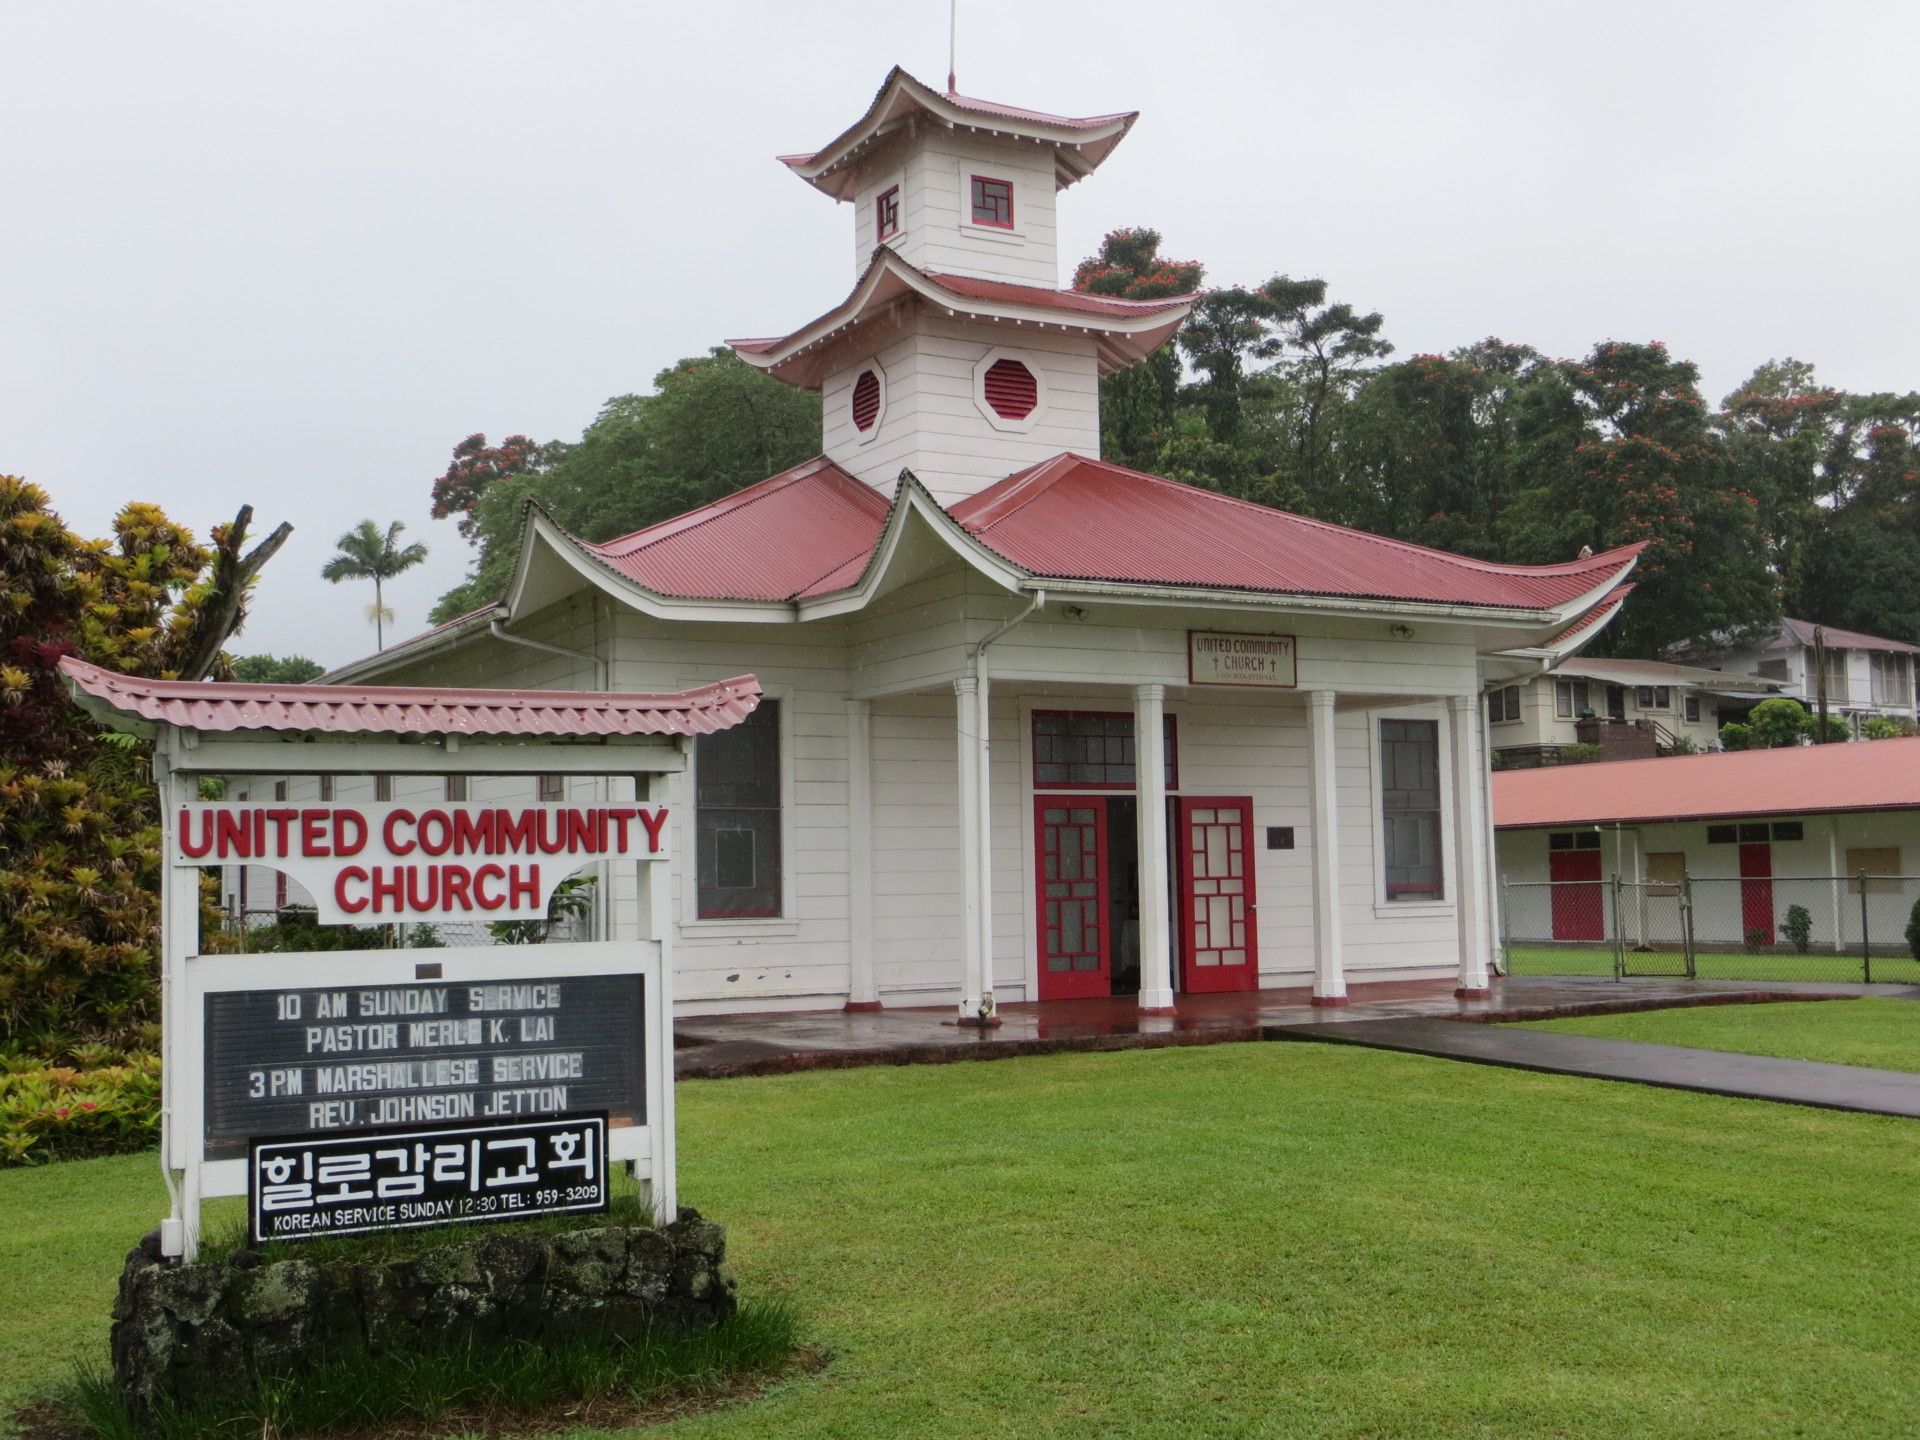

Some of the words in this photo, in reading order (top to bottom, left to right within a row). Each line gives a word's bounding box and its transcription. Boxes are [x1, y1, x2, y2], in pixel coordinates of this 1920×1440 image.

[1197, 637, 1231, 653] UNITED
[1224, 655, 1265, 671] CHURCH
[179, 808, 368, 857] UNITED
[383, 808, 669, 856] COMMUNITY
[334, 864, 541, 913] CHURCH
[278, 995, 301, 1020] 10
[316, 992, 348, 1019] AM
[359, 988, 448, 1016] SUNDAY
[469, 984, 561, 1012] SERVICE
[306, 1024, 399, 1053] PASTOR
[410, 1018, 482, 1048] MERLE
[490, 1019, 512, 1043] K.
[521, 1016, 554, 1042] LAI
[317, 1059, 479, 1094] MARSHALLESE
[493, 1053, 583, 1083] SERVICE
[370, 1093, 475, 1124] JOHNSON
[484, 1086, 567, 1116] JETTON
[261, 1127, 595, 1211] 힐로감리교회
[274, 1211, 331, 1231] KOREAN
[334, 1205, 396, 1226] SERVICE
[400, 1197, 454, 1219] SUNDAY
[458, 1195, 498, 1214] 12:30
[500, 1192, 532, 1209] TEL:
[535, 1184, 599, 1206] 959-3209
